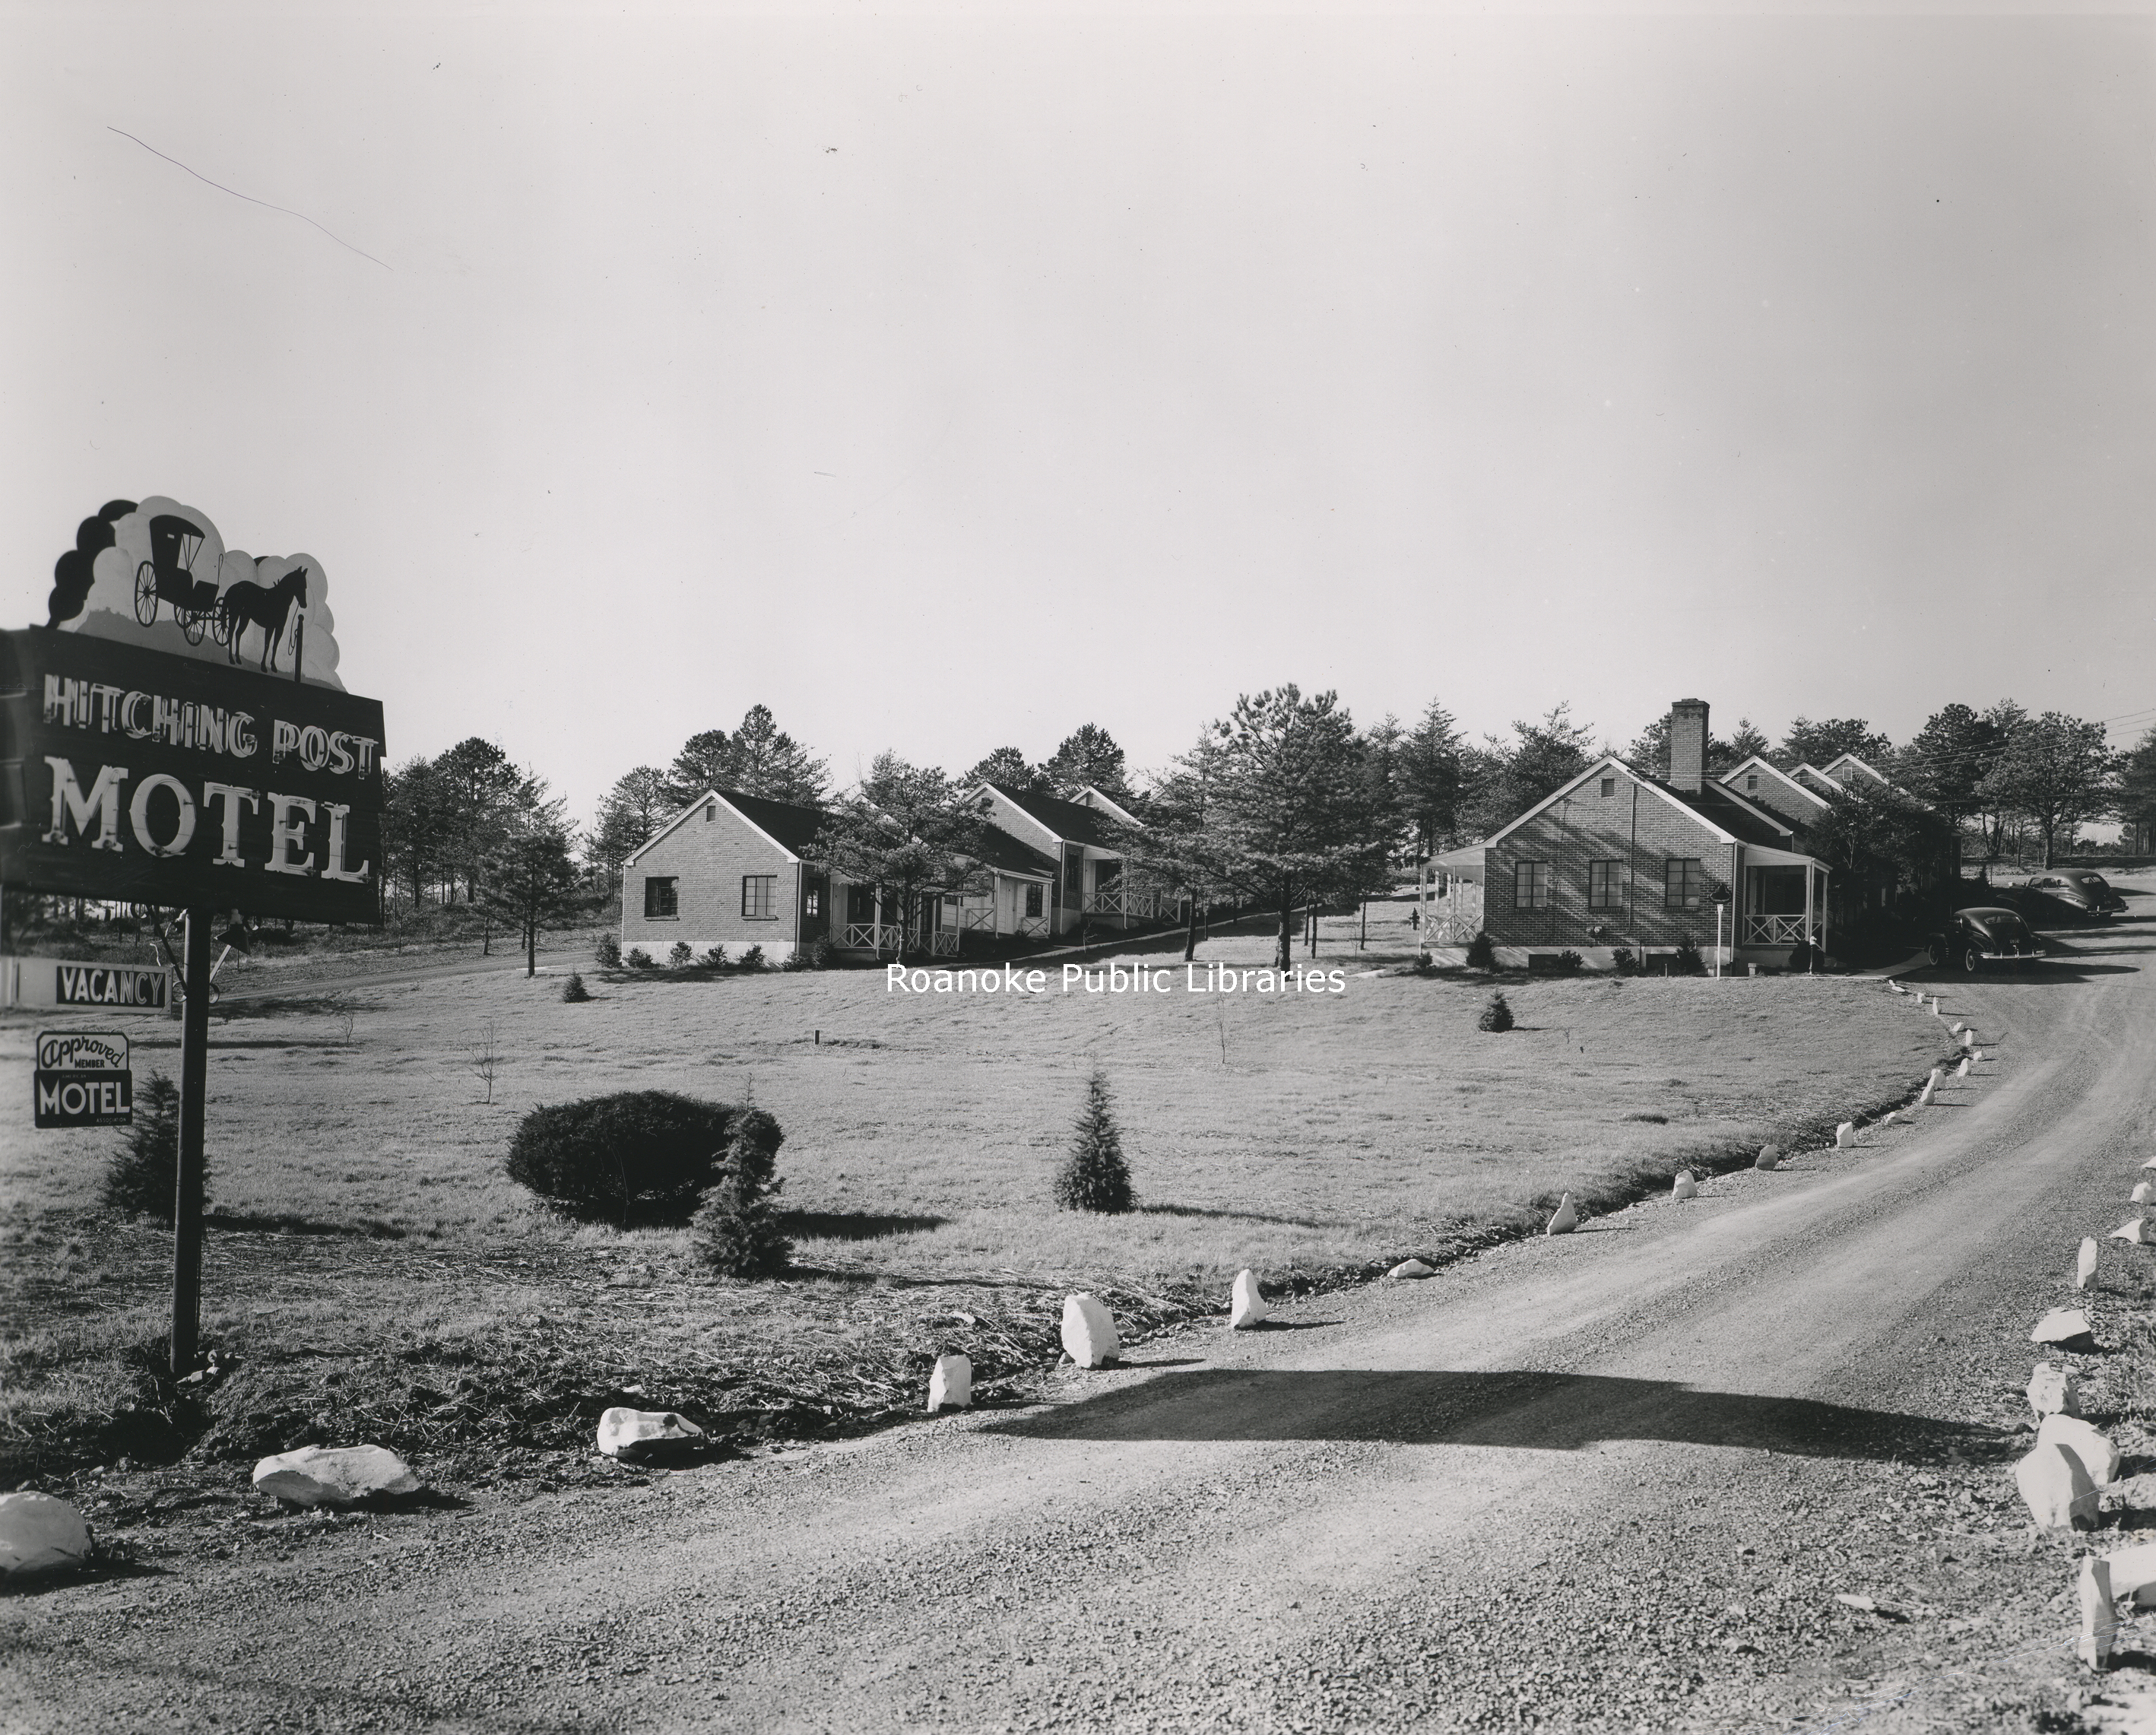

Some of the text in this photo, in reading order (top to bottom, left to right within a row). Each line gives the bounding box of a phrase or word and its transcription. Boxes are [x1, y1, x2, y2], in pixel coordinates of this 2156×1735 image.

[43, 674, 379, 780] HITCHING POST
[41, 755, 369, 884] MOTEL
[61, 966, 164, 1006] VACANCY
[41, 1036, 125, 1068] Approved
[75, 1058, 105, 1069] MEMBER
[40, 1077, 131, 1115] MOTEL
